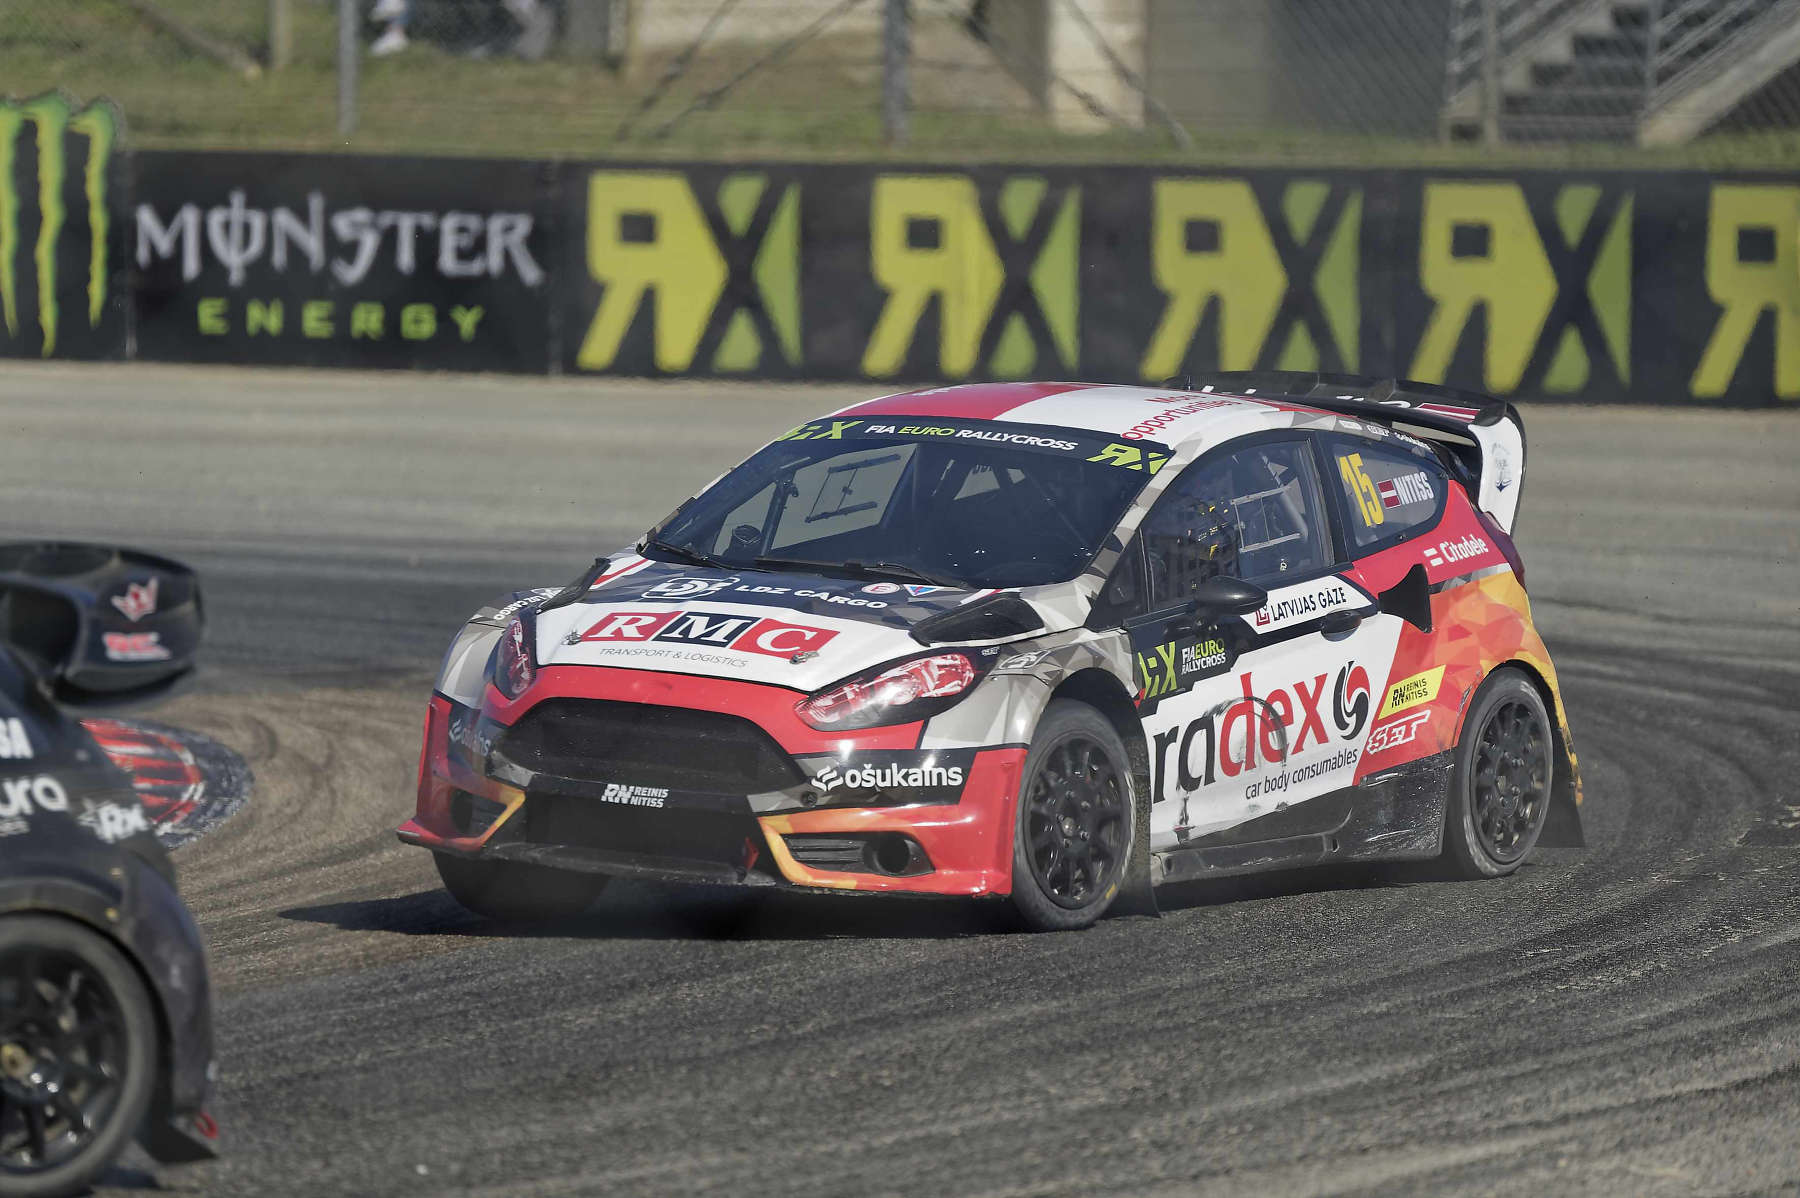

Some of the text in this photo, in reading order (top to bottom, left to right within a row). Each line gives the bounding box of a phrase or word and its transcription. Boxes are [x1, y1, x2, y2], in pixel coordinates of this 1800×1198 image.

[197, 297, 484, 341] ENERGY
[864, 425, 1079, 451] FIA EURO RALLYCROSS
[1339, 453, 1384, 527] 15
[1394, 471, 1434, 505] NITISS
[1438, 533, 1489, 563] Citadele
[733, 584, 888, 609] LDZ CARGO
[1271, 586, 1347, 621] LATVIJAS GĀZE
[588, 613, 818, 652] RMC
[599, 648, 749, 667] TRANSPORT & LOGISTICS
[1181, 653, 1226, 676] RALLYCROSS
[1153, 672, 1329, 804] radex
[845, 763, 963, 788] ošukains
[1245, 747, 1358, 800] car body consumables
[601, 784, 634, 804] RN
[630, 796, 664, 808] NITISS
[634, 786, 669, 798] REINIS
